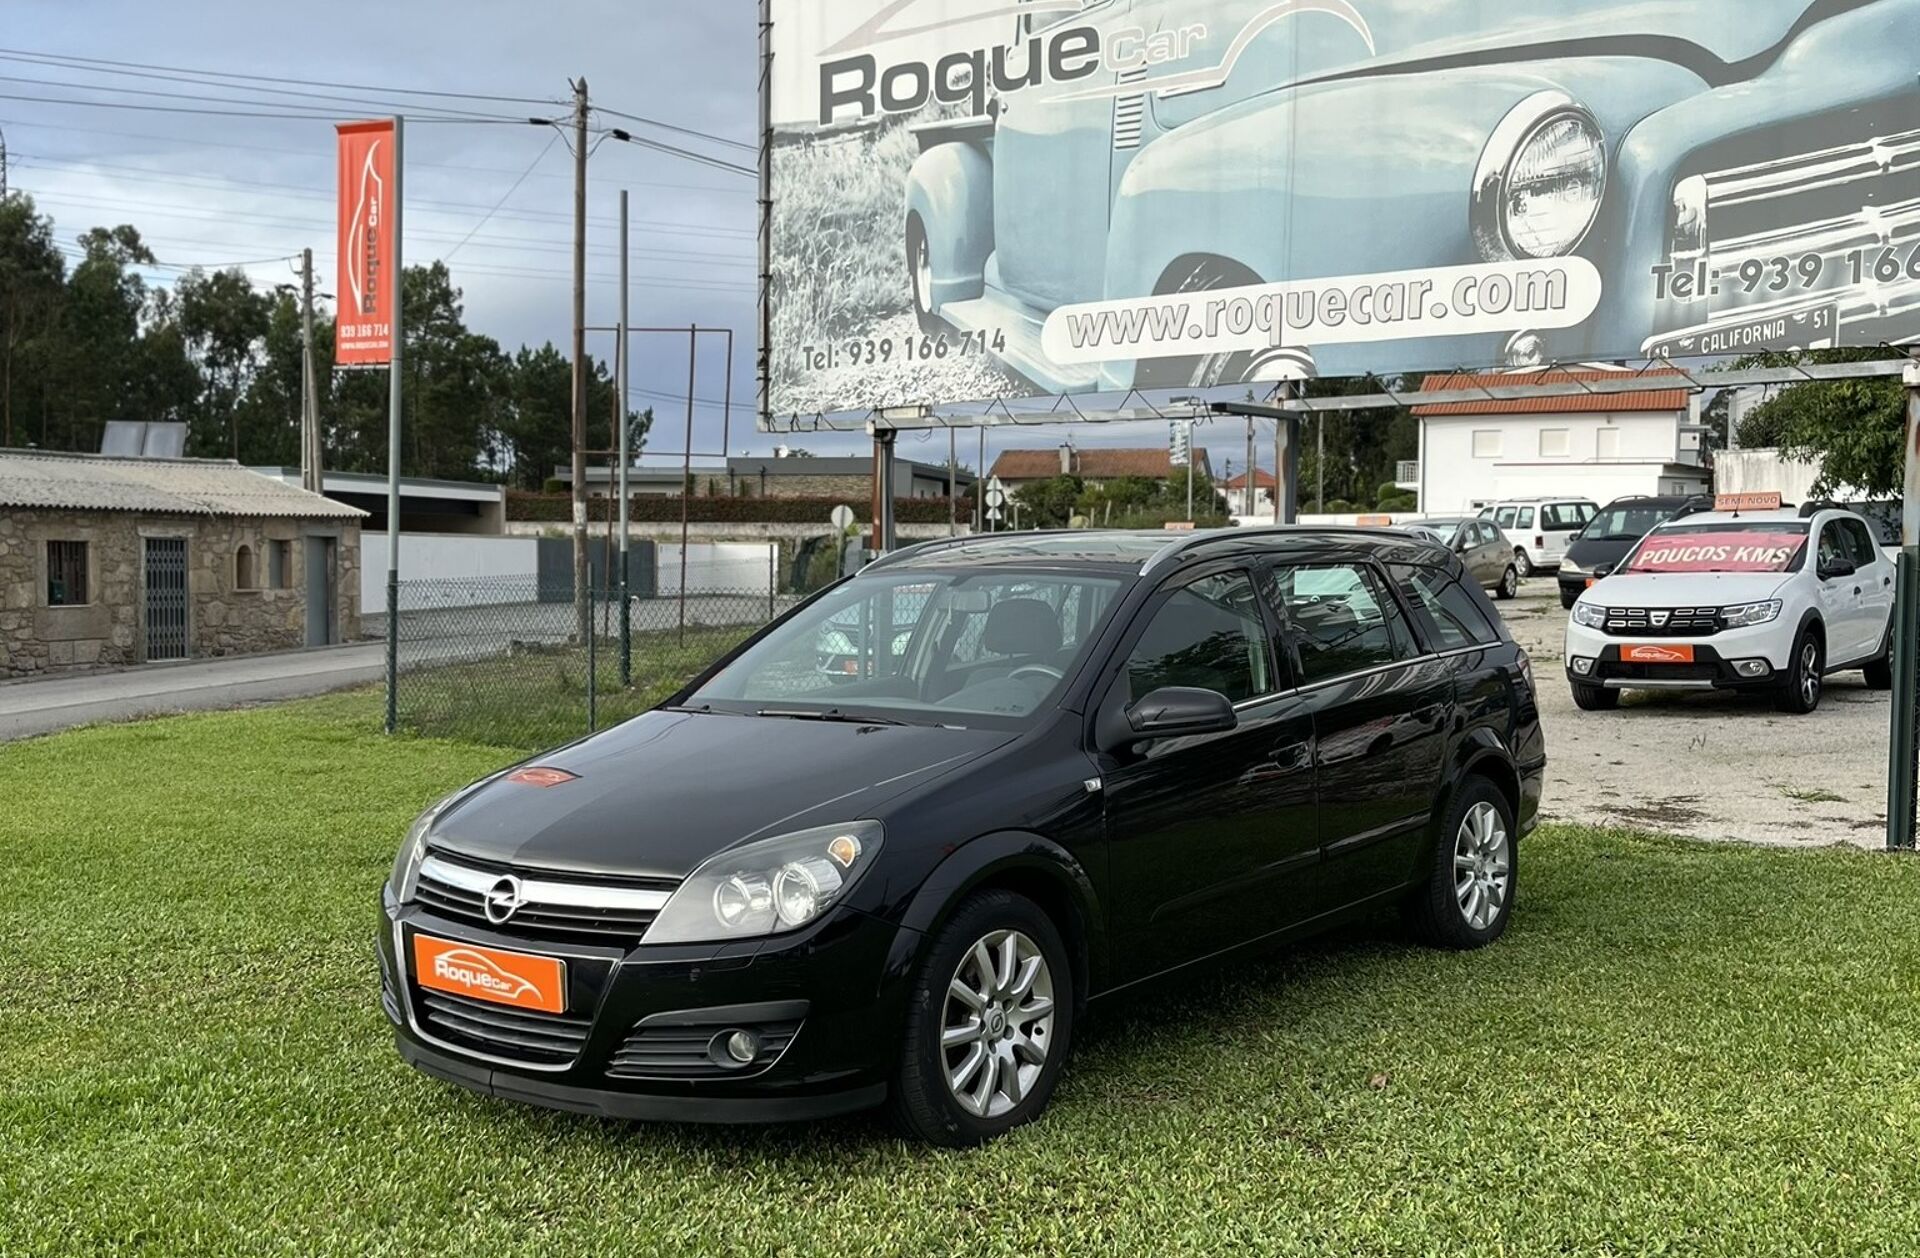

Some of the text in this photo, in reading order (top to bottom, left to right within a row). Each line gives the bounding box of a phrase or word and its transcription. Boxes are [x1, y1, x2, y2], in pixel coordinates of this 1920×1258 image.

[1651, 260, 1720, 300] Tel:
[1739, 253, 1823, 292] 939
[1066, 267, 1568, 348] www.roquecar.com
[803, 327, 1006, 371] Tel: 939 166 714
[1700, 319, 1786, 354] CALIFORNIA
[1813, 309, 1829, 328] 51
[1747, 496, 1778, 504] NOVO
[1637, 546, 1792, 566] POUCOS KMS
